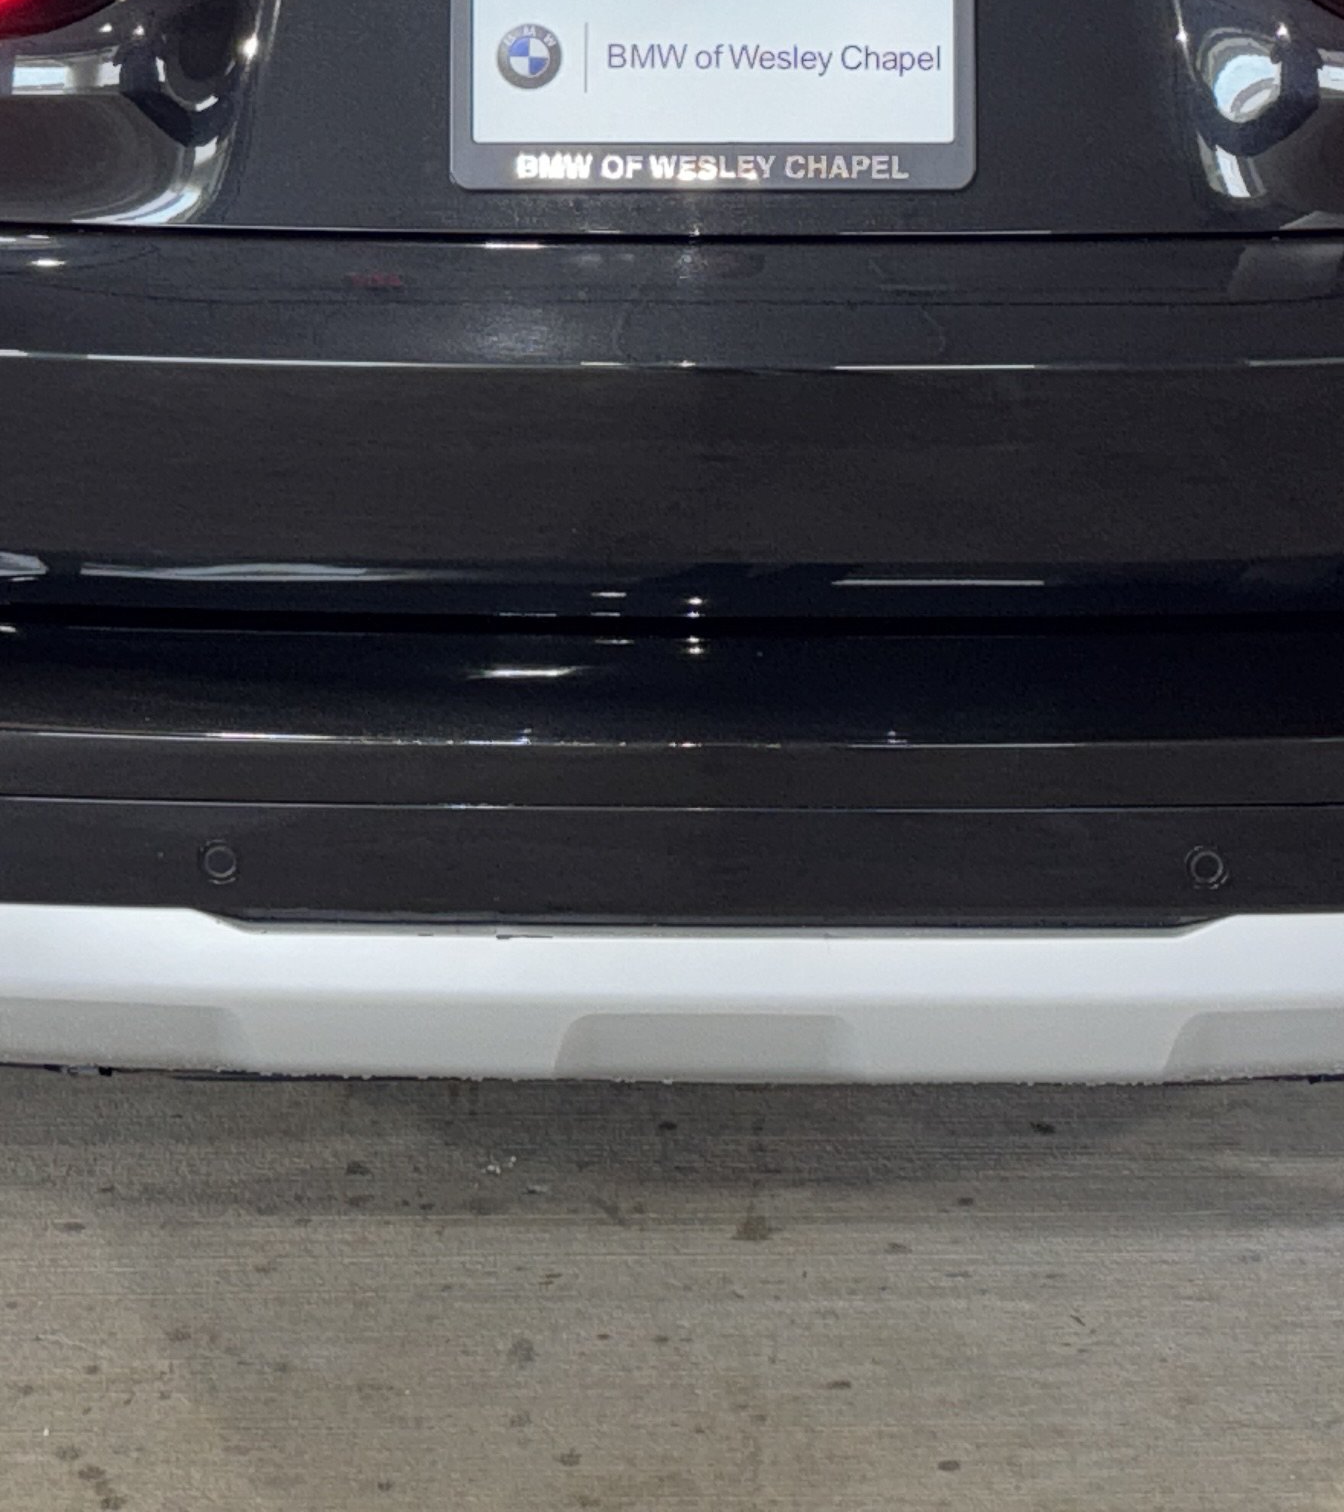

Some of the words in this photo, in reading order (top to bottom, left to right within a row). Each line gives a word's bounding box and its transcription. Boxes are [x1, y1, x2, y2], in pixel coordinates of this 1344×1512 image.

[607, 44, 688, 69] BMW
[695, 43, 724, 69] of
[729, 44, 832, 76] Wesley
[841, 44, 941, 77] Chapel
[516, 153, 593, 180] BMW
[601, 155, 644, 180] OF
[649, 155, 776, 181] WESLEY
[784, 155, 909, 179] CHAPEL
